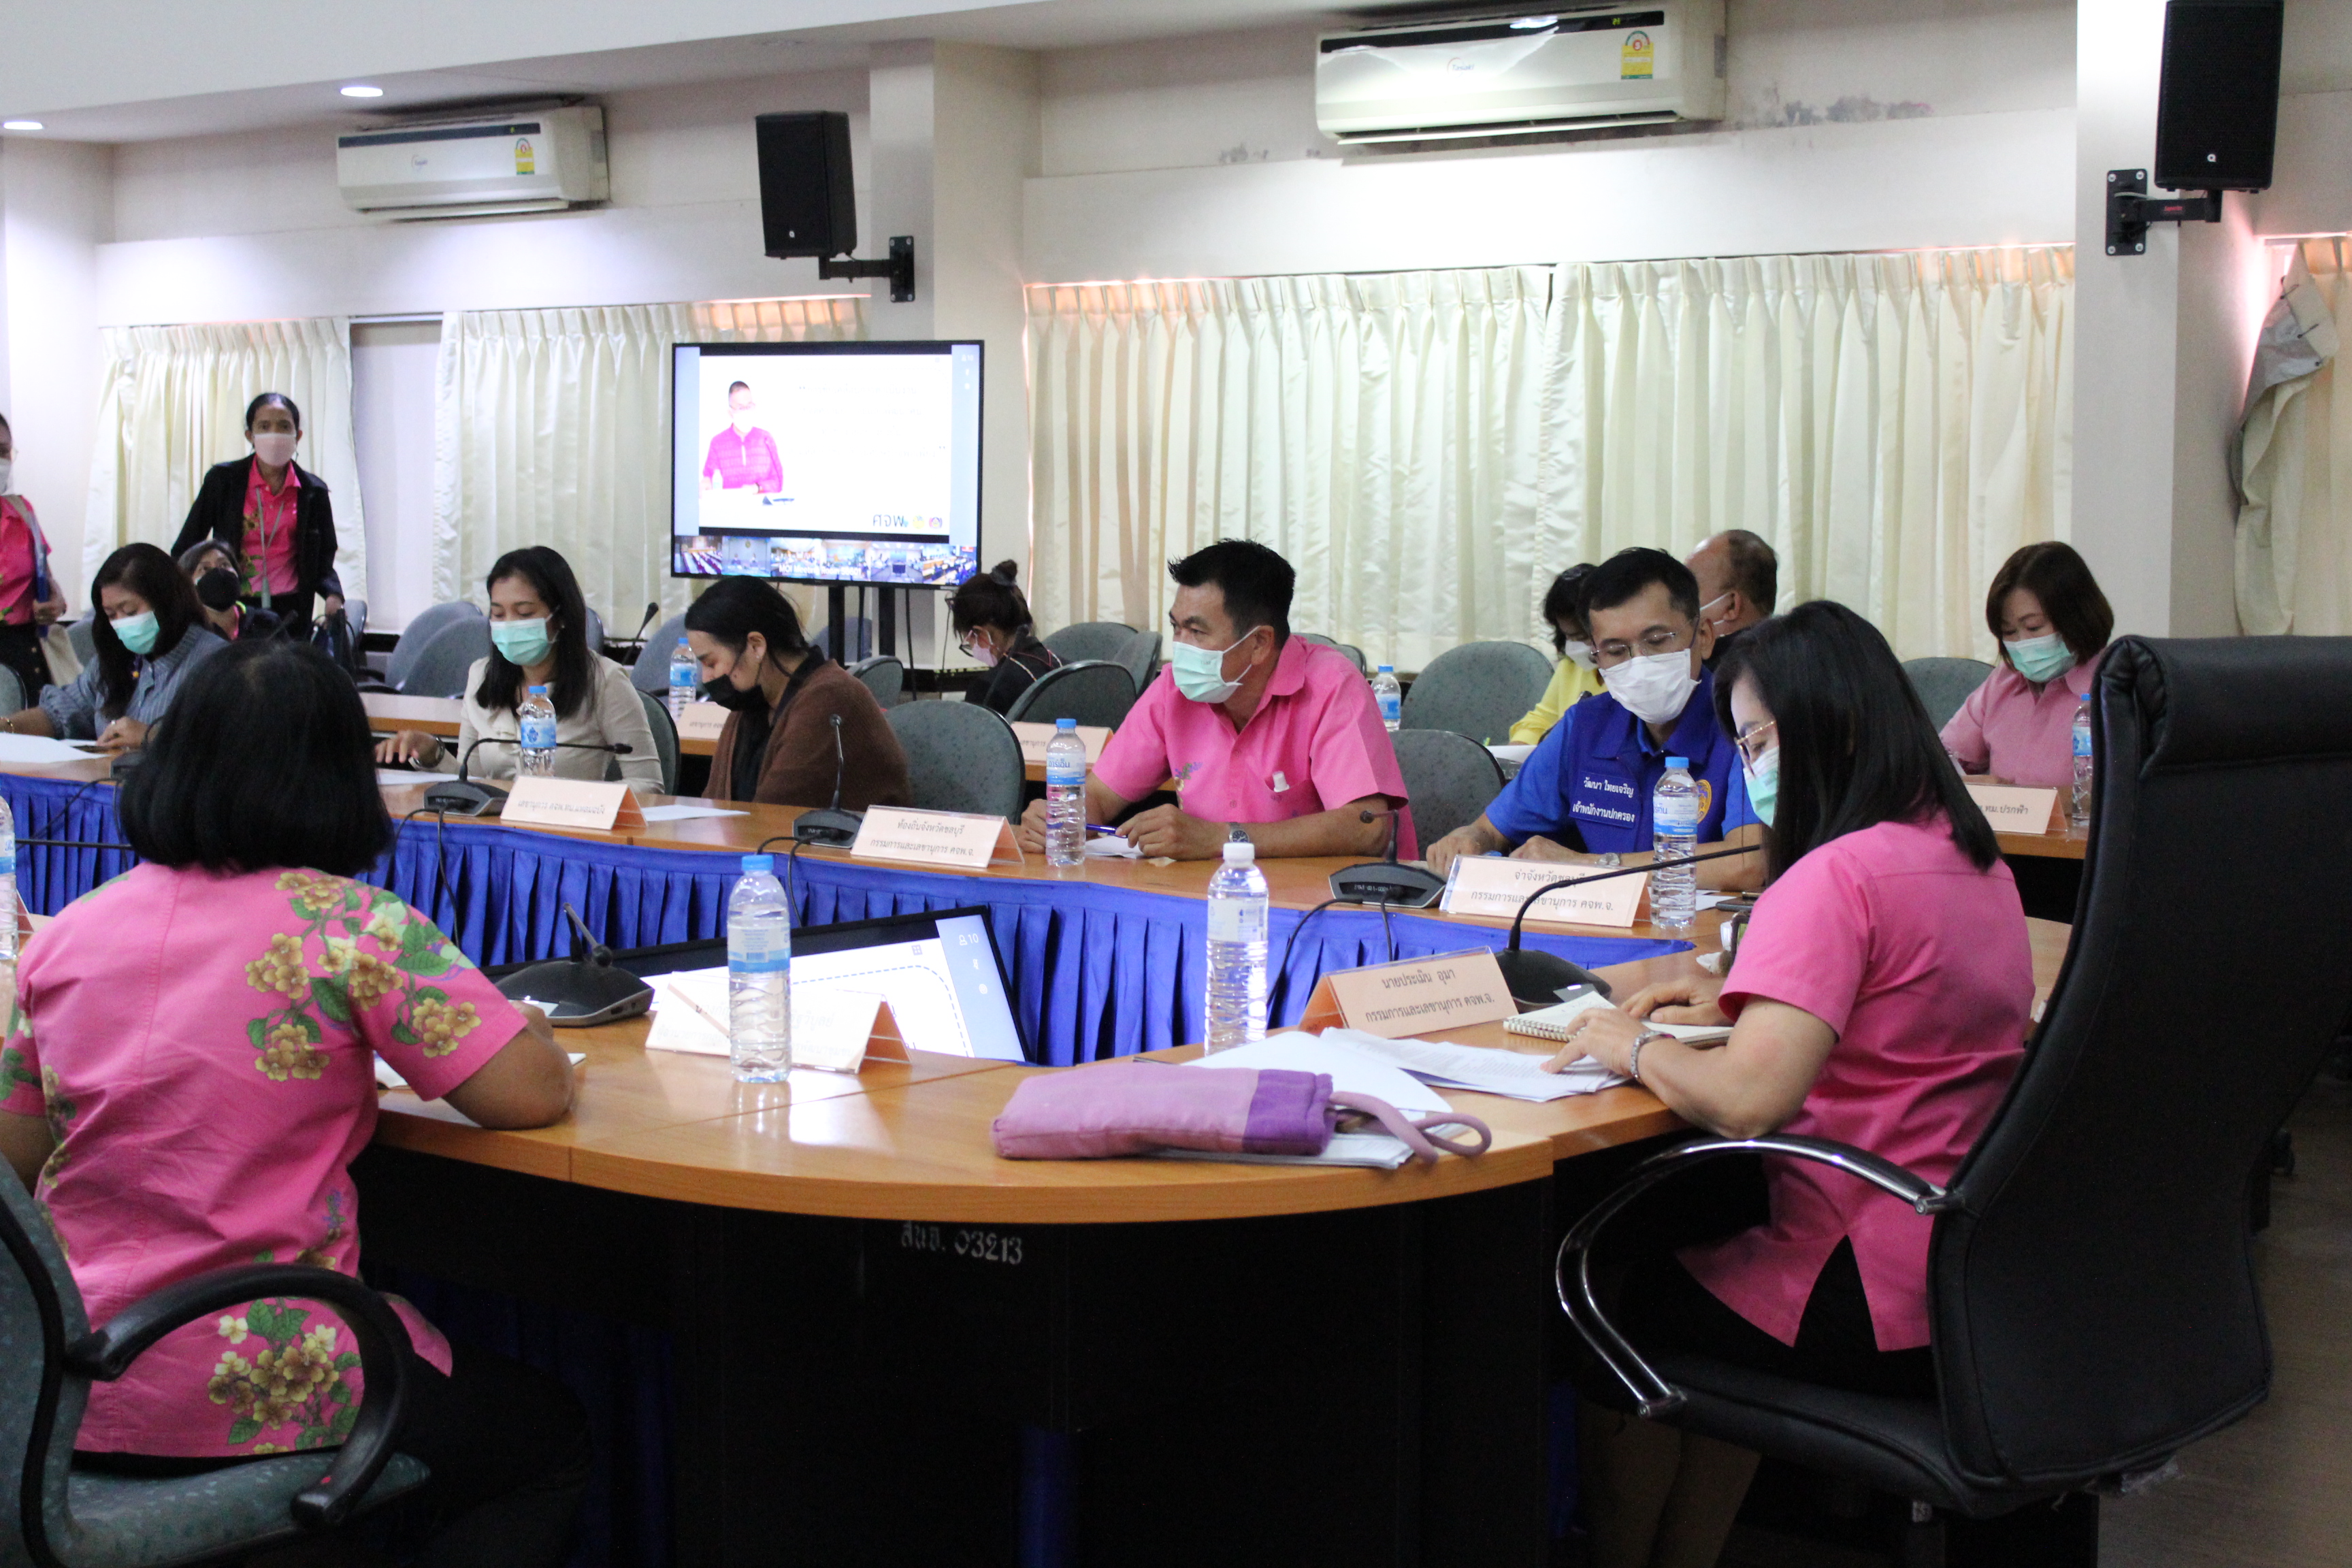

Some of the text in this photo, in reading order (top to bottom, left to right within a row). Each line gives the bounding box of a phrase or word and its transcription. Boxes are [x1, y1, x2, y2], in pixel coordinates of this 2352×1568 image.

[1572, 800, 1635, 823] เจ้าพนักงานปกครอง
[870, 838, 948, 855] กรรมการและเลขานุการ
[1580, 899, 1614, 911] คจพ.จ.
[967, 933, 979, 944] 10
[1382, 968, 1456, 990] นายประเมิน อุมา
[1365, 992, 1495, 1023] กรรมการและเลขานุการ คจพ.จ.
[954, 1229, 1023, 1266] 03213
